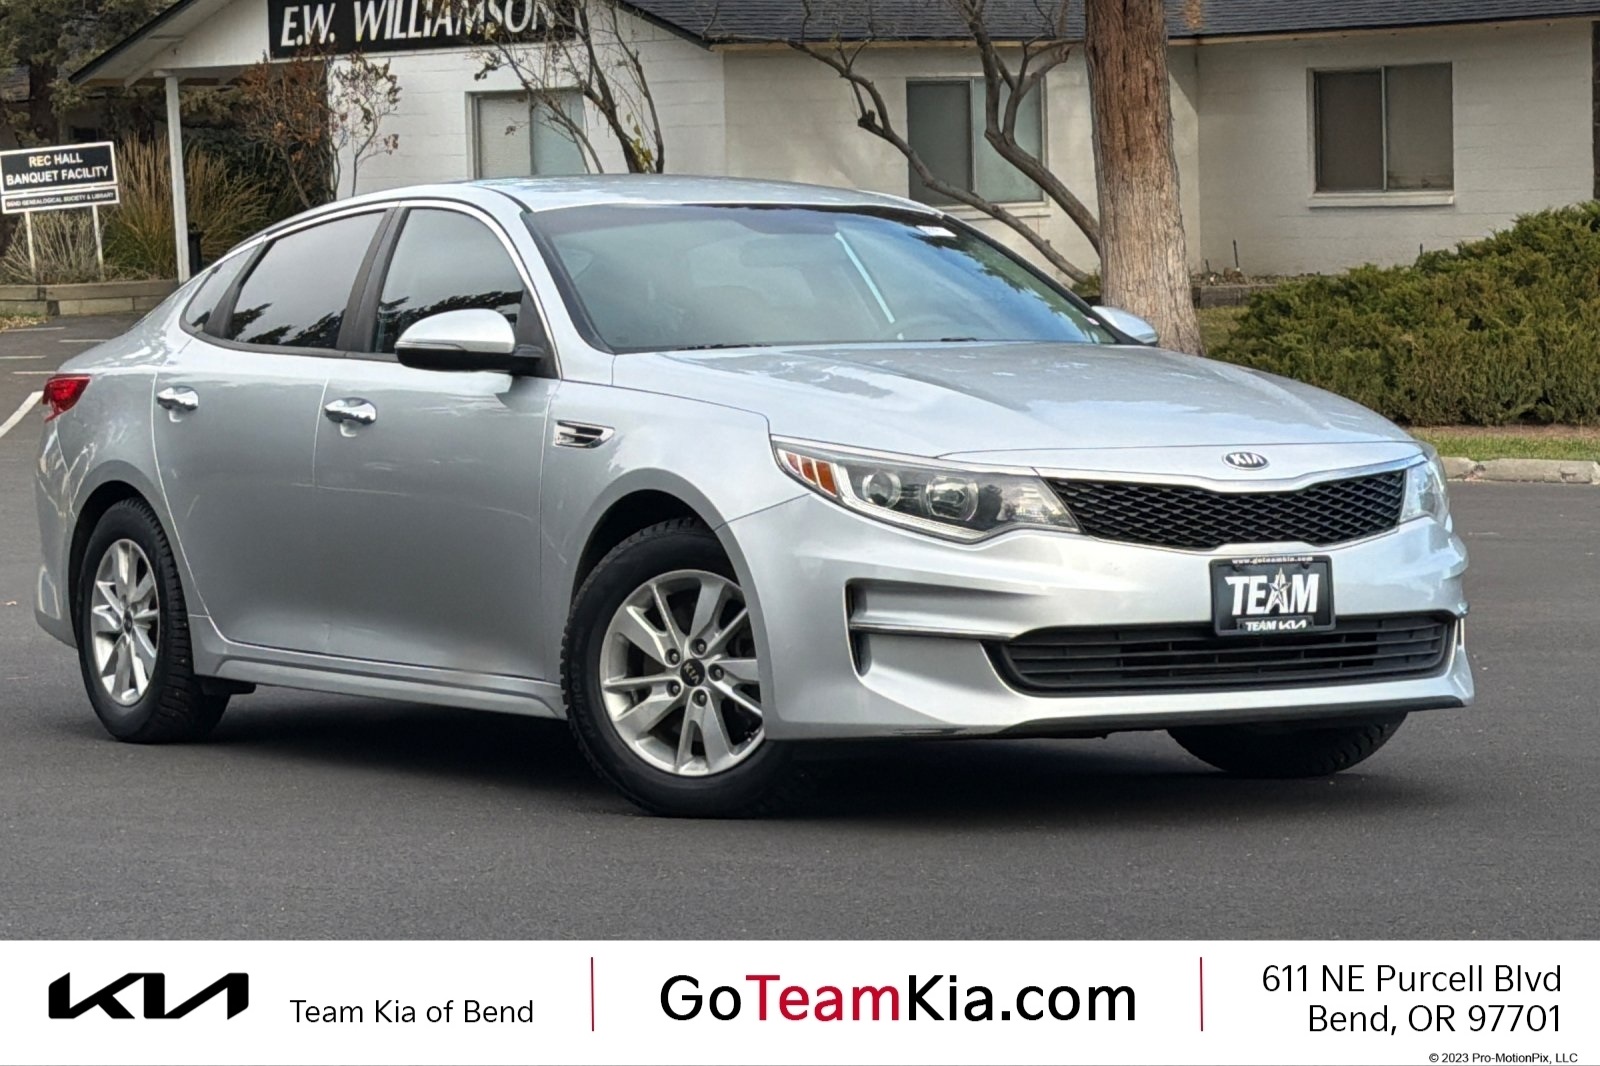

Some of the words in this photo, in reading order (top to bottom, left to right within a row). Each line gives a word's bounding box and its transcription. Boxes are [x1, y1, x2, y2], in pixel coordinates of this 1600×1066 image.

[280, 3, 336, 47] E.W.
[353, 0, 556, 41] WILLIAMSON
[29, 155, 51, 168] REC
[54, 152, 83, 165] HALL
[6, 170, 59, 186] BANQUET
[61, 165, 108, 180] FACILITY
[1229, 453, 1262, 465] KIA
[1224, 568, 1320, 615] TEAM
[1245, 620, 1277, 631] TEAM
